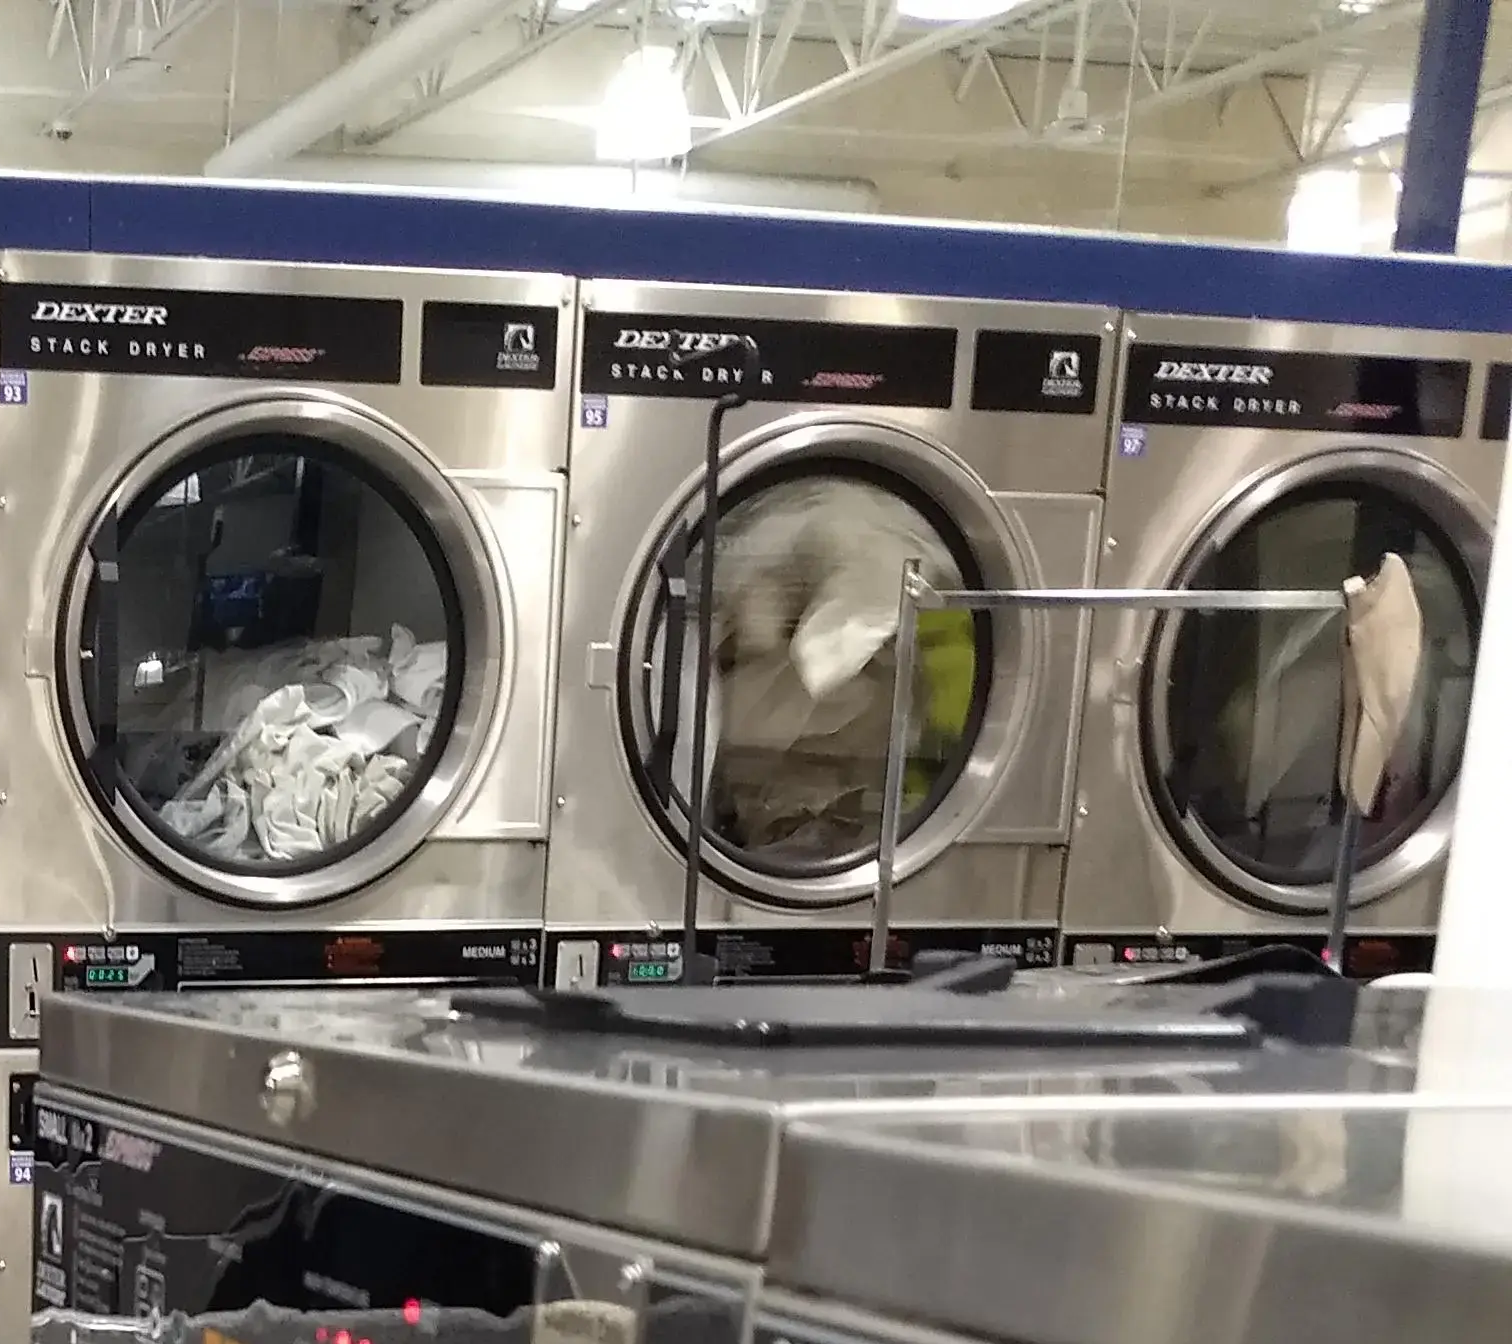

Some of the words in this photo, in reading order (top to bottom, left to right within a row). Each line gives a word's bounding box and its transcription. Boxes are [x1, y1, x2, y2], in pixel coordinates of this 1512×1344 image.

[31, 300, 168, 325] DEXTER
[30, 336, 108, 355] STACK
[129, 340, 205, 359] DRYER
[702, 366, 774, 386] DRYR
[1153, 360, 1274, 384] DEXTER
[4, 385, 22, 402] 93
[1149, 392, 1220, 411] STACK
[585, 408, 603, 424] 95
[14, 1166, 32, 1182] 94
